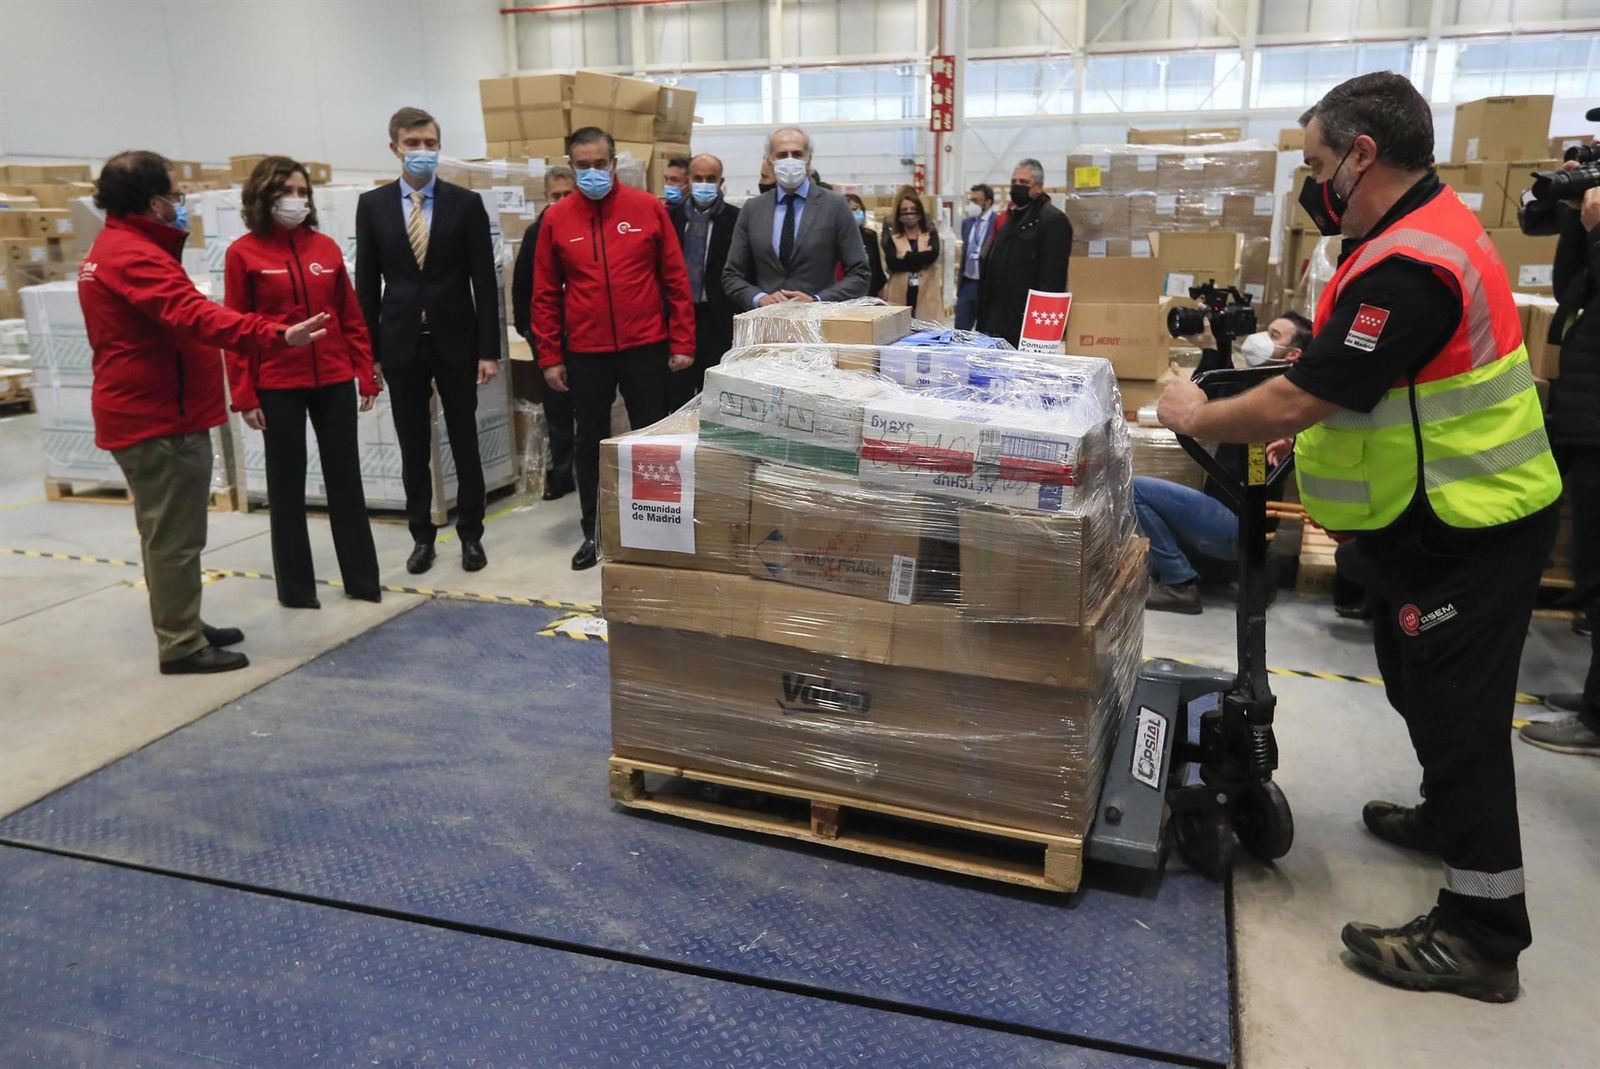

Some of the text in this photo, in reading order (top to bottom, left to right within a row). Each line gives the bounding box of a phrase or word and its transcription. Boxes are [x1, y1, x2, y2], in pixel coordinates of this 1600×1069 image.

[632, 502, 681, 514] Comunidad
[632, 511, 681, 524] de Madrid
